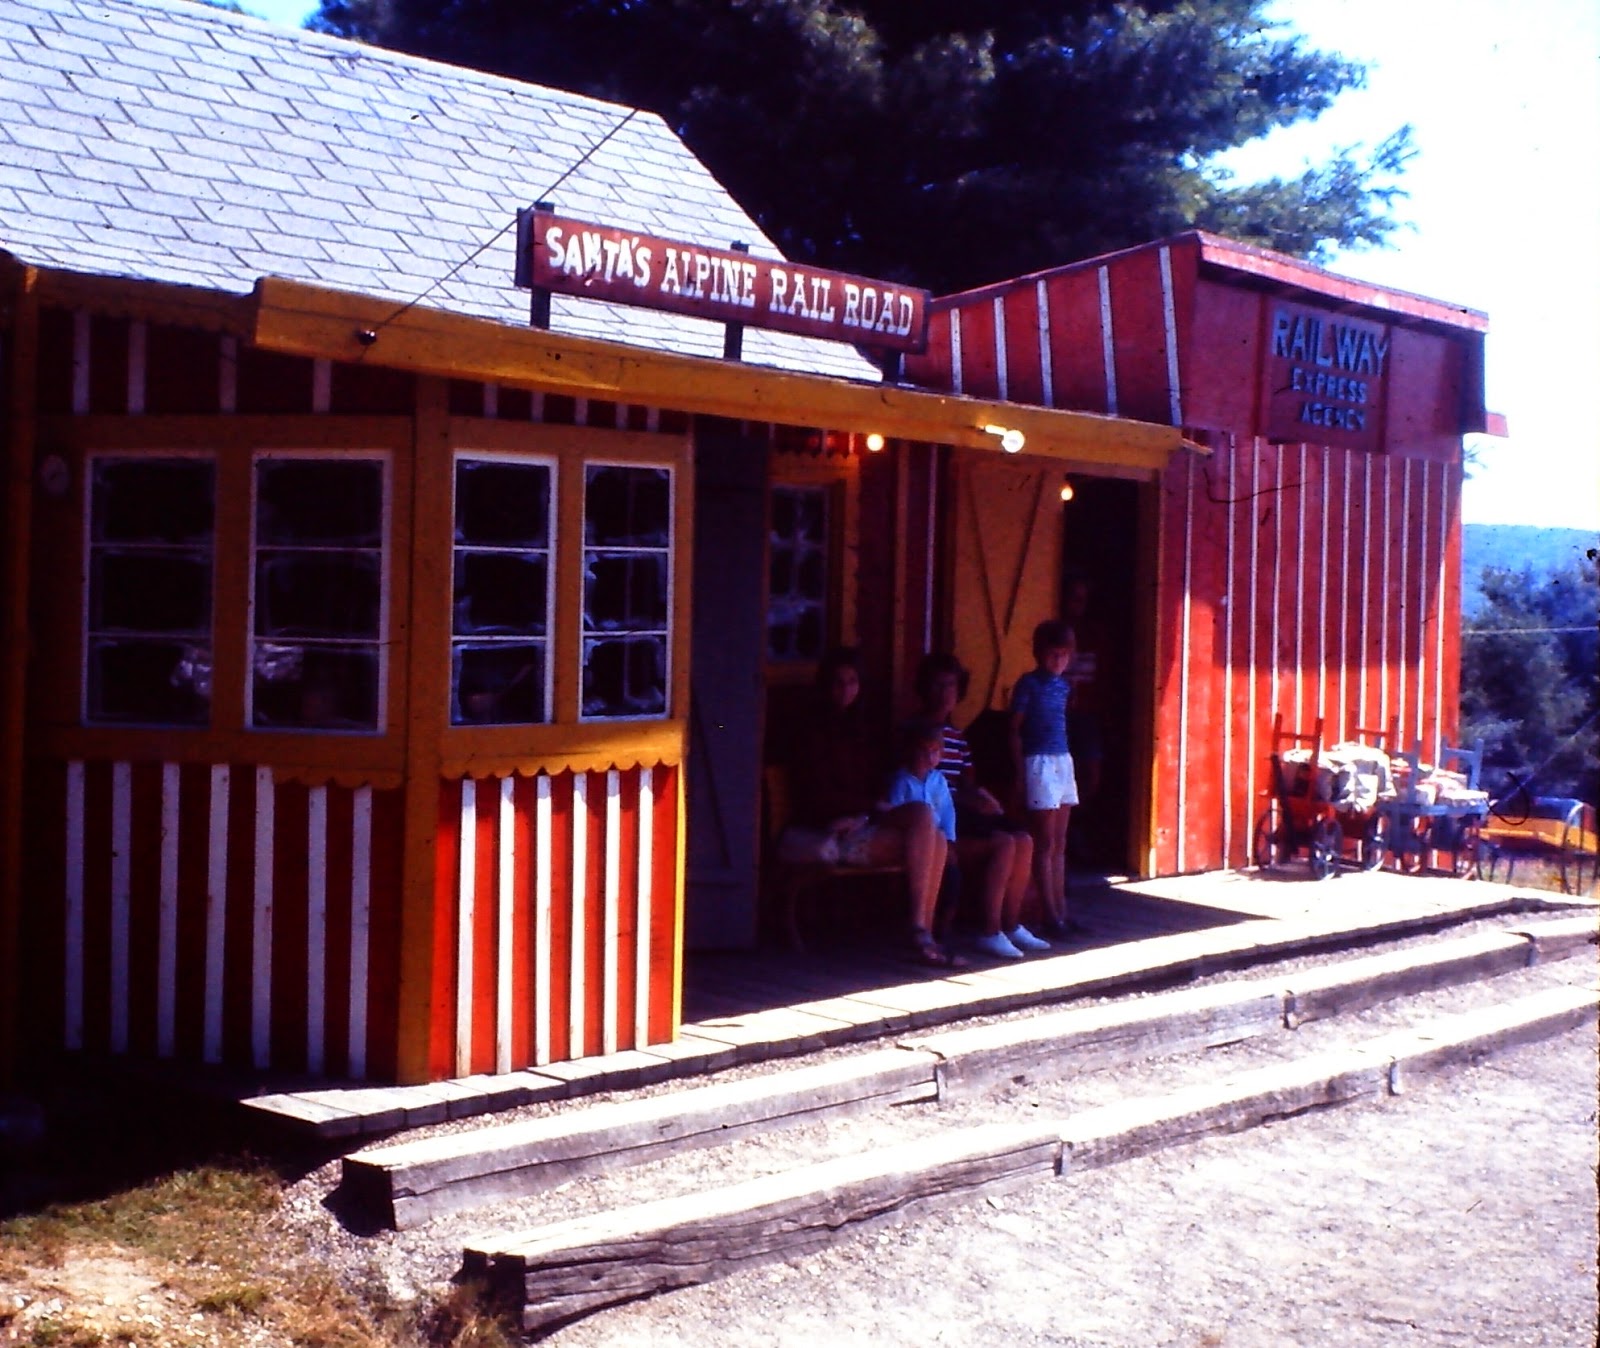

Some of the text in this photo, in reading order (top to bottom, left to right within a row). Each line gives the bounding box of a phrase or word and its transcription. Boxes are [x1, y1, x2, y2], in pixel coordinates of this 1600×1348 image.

[545, 226, 914, 336] SANTA'S ALPINE RAIL ROAD
[1271, 309, 1388, 377] RAILWAY
[1291, 366, 1367, 404] EXPRESS
[1301, 402, 1366, 431] AGENCY
